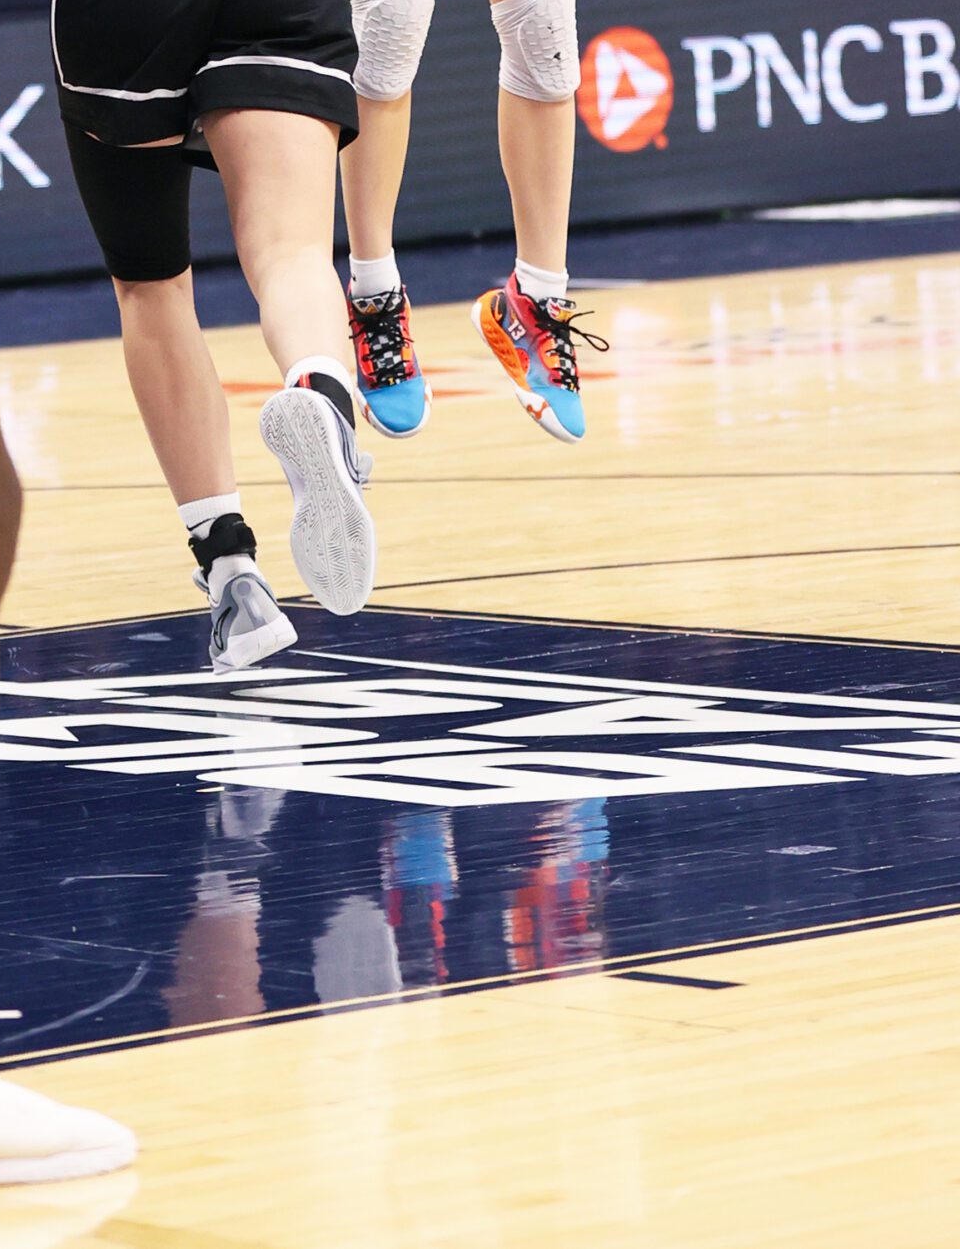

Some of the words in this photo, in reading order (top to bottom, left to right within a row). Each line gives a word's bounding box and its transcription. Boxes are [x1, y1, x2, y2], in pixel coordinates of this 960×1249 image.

[681, 24, 888, 133] PNC
[889, 18, 960, 117] B
[507, 318, 527, 341] 13
